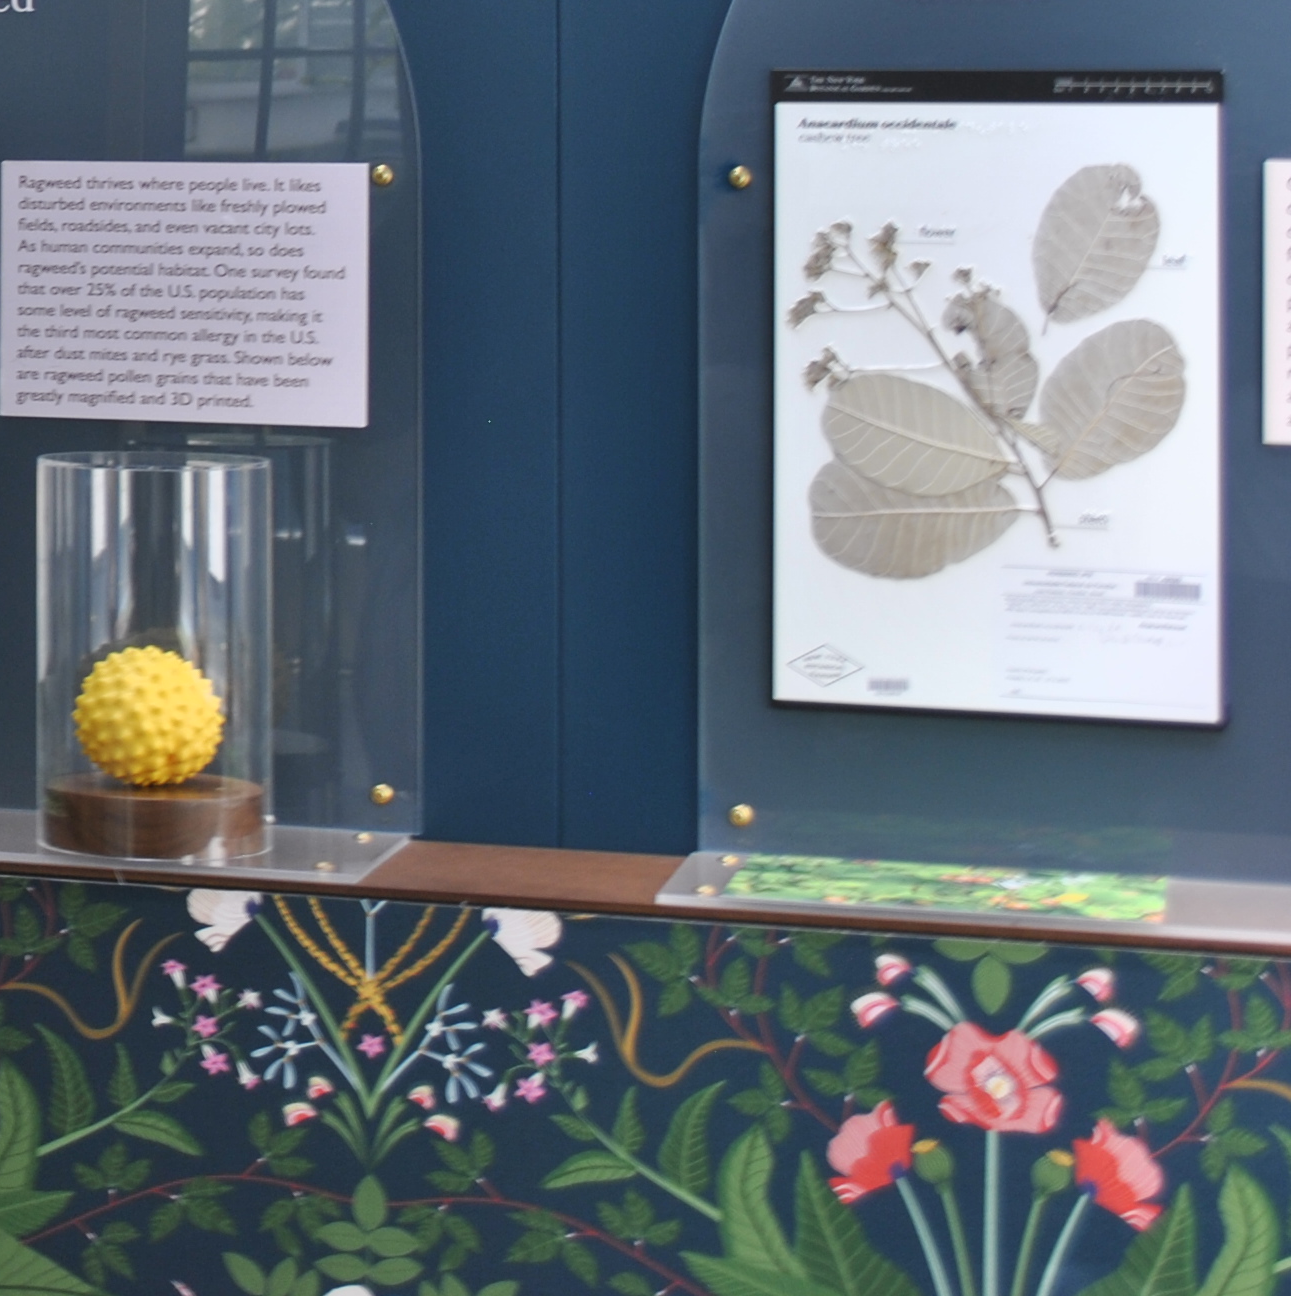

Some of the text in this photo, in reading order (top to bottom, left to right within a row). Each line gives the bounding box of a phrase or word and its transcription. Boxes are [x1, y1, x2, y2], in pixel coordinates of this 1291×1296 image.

[17, 176, 321, 195] Ragweed thrives where people live. It likes
[17, 197, 327, 218] disturbed environments like freshly plowed
[134, 219, 161, 234] and
[164, 223, 199, 234] even
[203, 220, 249, 235] vacant
[253, 221, 280, 239] city
[283, 221, 315, 236] lots.
[17, 239, 37, 254] As
[39, 240, 88, 254] human
[91, 240, 184, 256] communities
[246, 245, 265, 257] so
[268, 243, 304, 257] does
[90, 262, 154, 280] potential
[157, 263, 210, 278] habitat.
[213, 263, 247, 278] One
[250, 267, 299, 282] survey
[302, 265, 346, 280] found
[16, 282, 46, 296] that
[49, 285, 81, 297] over
[87, 283, 117, 298] 25%
[119, 283, 136, 298] of
[138, 284, 163, 298] the
[197, 285, 277, 304] population
[279, 286, 305, 301] has
[16, 306, 56, 318] some
[59, 304, 92, 319] level
[95, 304, 111, 319] of
[114, 305, 176, 323] ragweed
[255, 307, 308, 326] making
[311, 308, 323, 323] it
[16, 324, 41, 339] the
[43, 325, 79, 340] third
[82, 326, 120, 340] most
[122, 329, 188, 342] common
[191, 328, 239, 346] allergy
[242, 329, 257, 343] in
[260, 329, 286, 344] the
[15, 345, 333, 367] after dust mites and rye grass. Shown below
[15, 367, 310, 388] are ragweed pollen grains that have been
[15, 388, 254, 411] greatly magnified and 3D printed.
